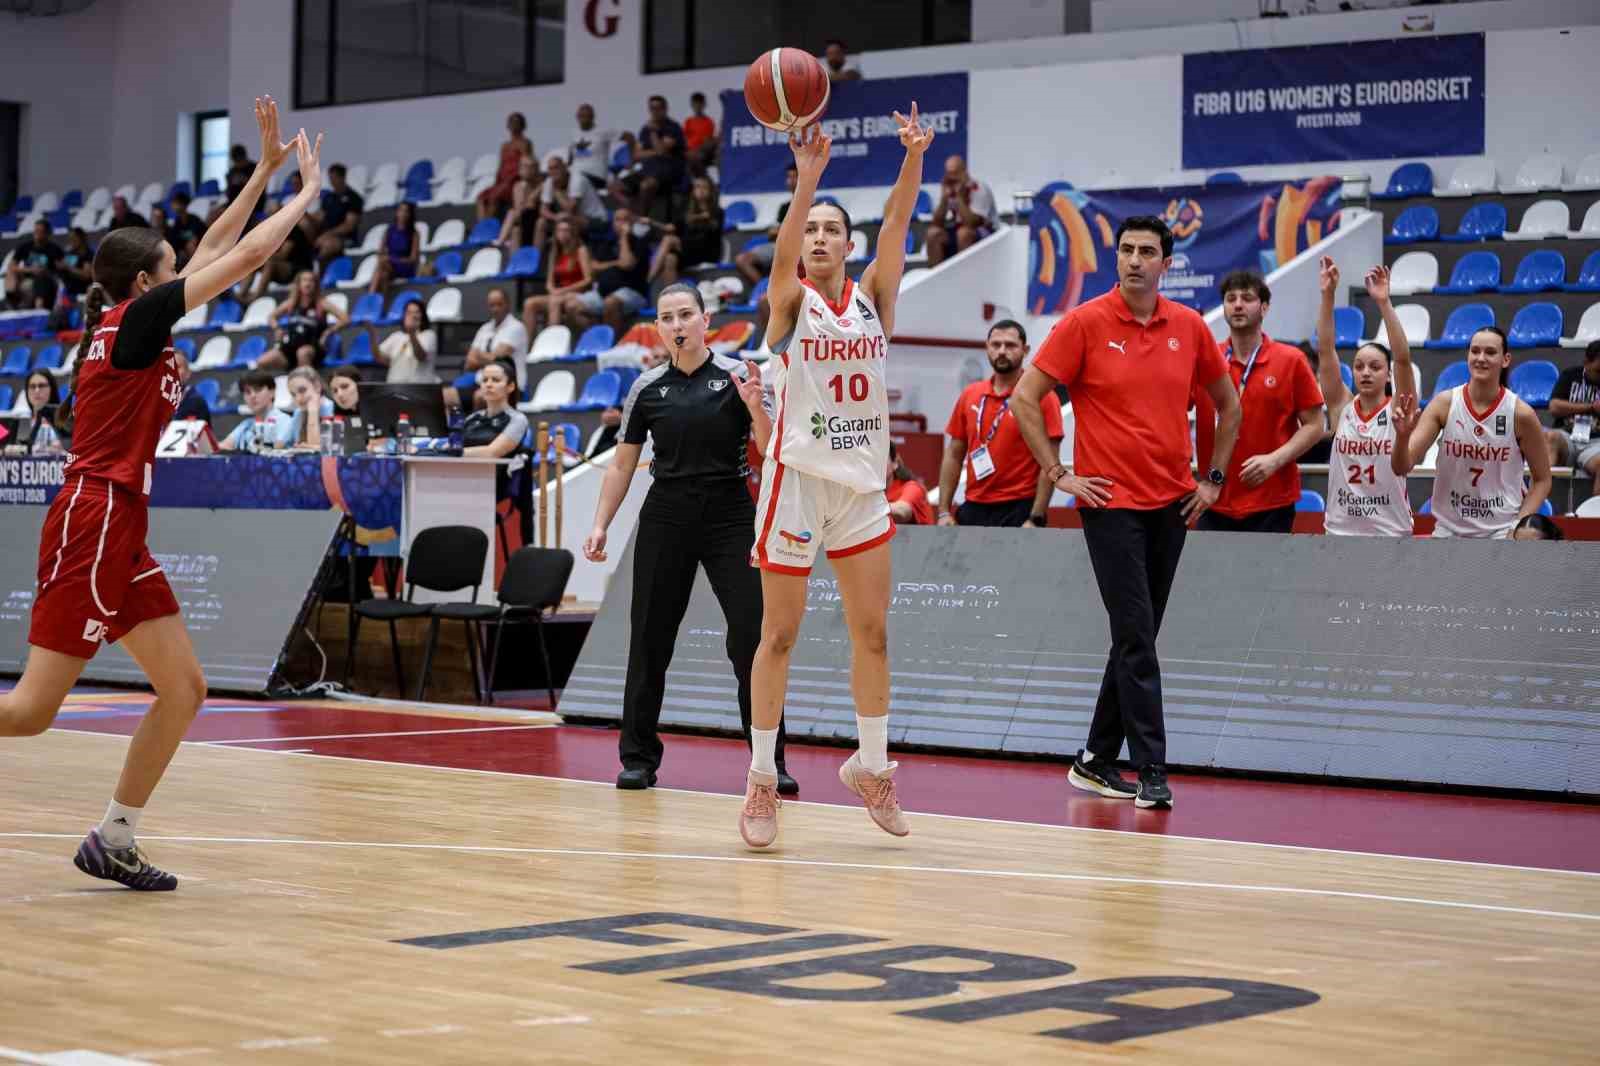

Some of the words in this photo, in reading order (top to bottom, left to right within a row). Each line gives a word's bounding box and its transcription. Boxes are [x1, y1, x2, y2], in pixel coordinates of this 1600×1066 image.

[1194, 91, 1231, 116] FIBA
[1235, 89, 1266, 113] U16
[1269, 83, 1351, 111] WOMEN'S
[1355, 76, 1472, 106] EUROBASKET
[828, 373, 869, 403] 10
[828, 413, 882, 433] Garanti
[831, 433, 871, 451] BBVA
[1444, 439, 1511, 461] TÜRKİYE
[22, 460, 65, 486] EUROB
[1347, 464, 1376, 485] 21
[1469, 467, 1484, 488] 7
[1347, 493, 1390, 506] Garanti
[1461, 494, 1504, 509] Garanti
[1347, 505, 1379, 517] BBVA
[1461, 507, 1495, 519] BBVA
[393, 911, 1322, 1044] FIBA
